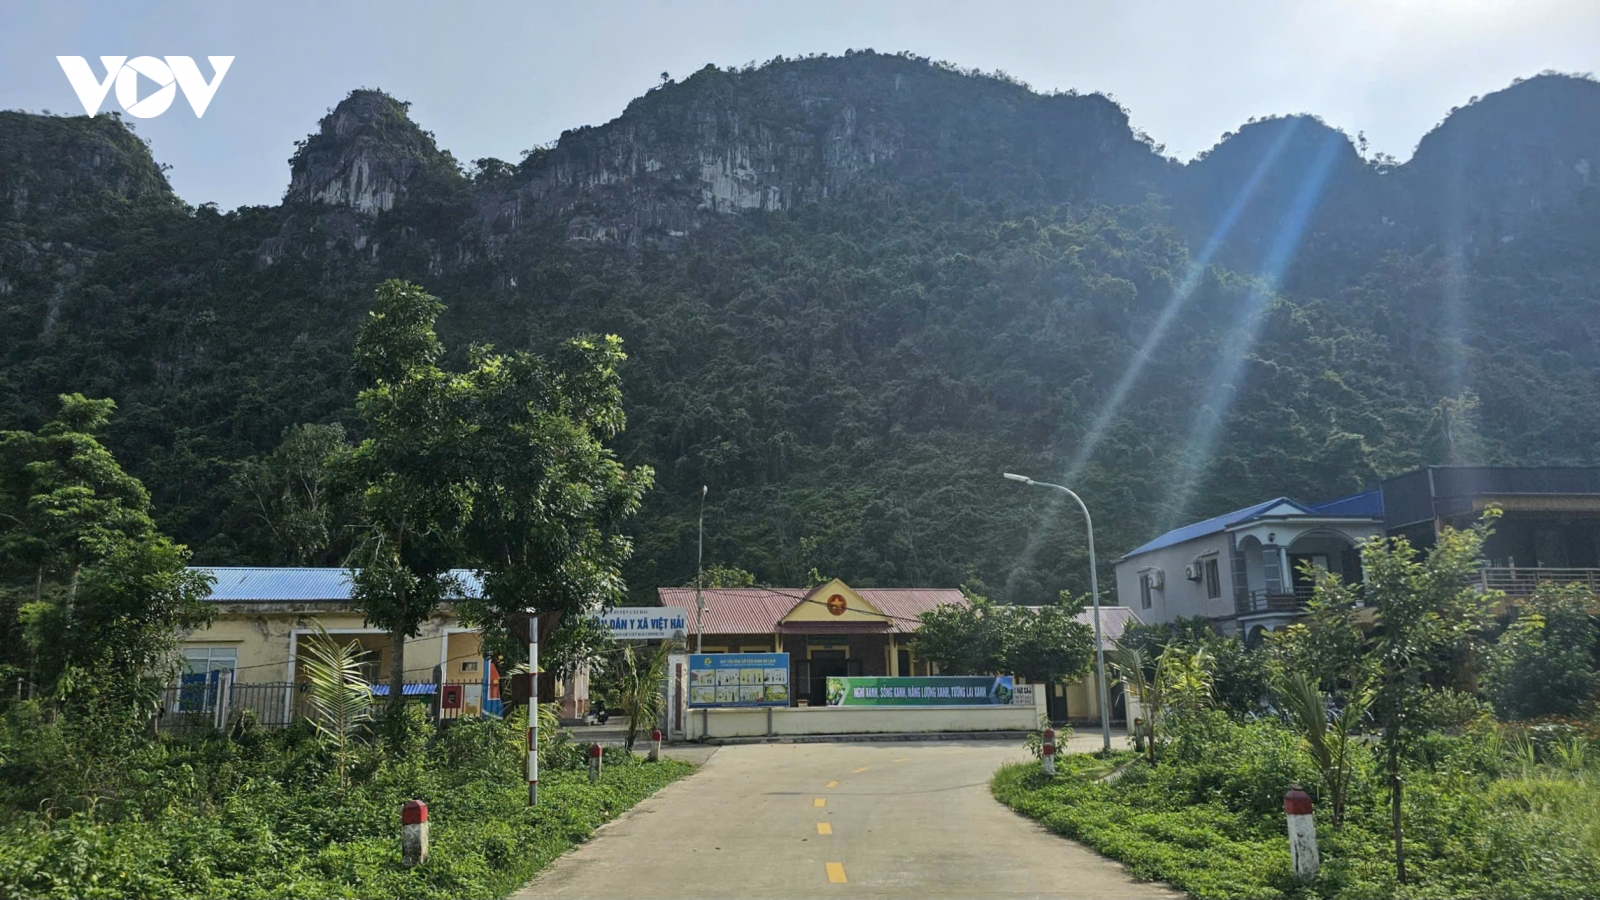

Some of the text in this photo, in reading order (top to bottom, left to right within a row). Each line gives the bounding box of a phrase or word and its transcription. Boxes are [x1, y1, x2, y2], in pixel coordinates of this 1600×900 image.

[610, 617, 627, 630] DÂN
[629, 619, 635, 630] Y
[637, 617, 649, 630] XÃ
[650, 616, 669, 631] VIỆT
[670, 614, 684, 629] HẢI
[879, 683, 893, 698] SỐNG
[921, 685, 936, 700] LƯỢNG
[950, 685, 965, 698] TƯƠNG
[973, 686, 987, 698] XANH
